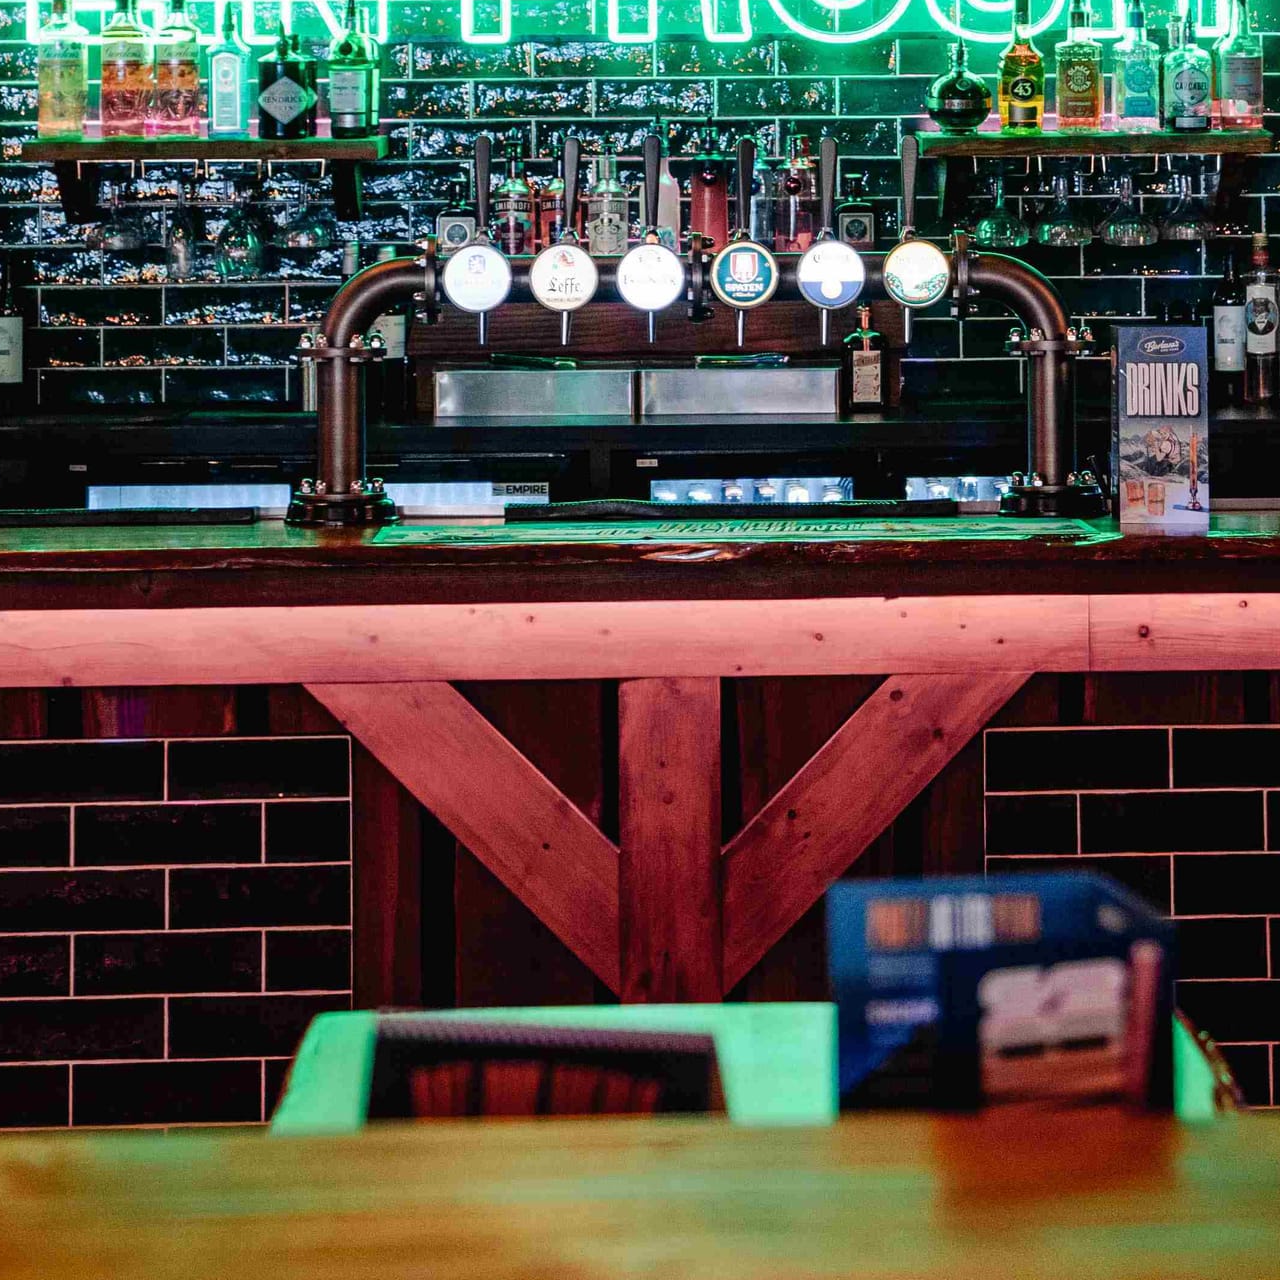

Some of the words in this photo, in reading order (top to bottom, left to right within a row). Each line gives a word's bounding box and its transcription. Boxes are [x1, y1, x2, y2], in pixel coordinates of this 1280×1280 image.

[1013, 82, 1032, 97] 43
[1174, 81, 1208, 91] CACABEL
[495, 200, 531, 211] SMIRNOFF
[548, 277, 579, 295] Leffe
[725, 282, 764, 293] SPATEN
[1125, 362, 1200, 417] DRINKS
[505, 485, 548, 495] EMPIRE
